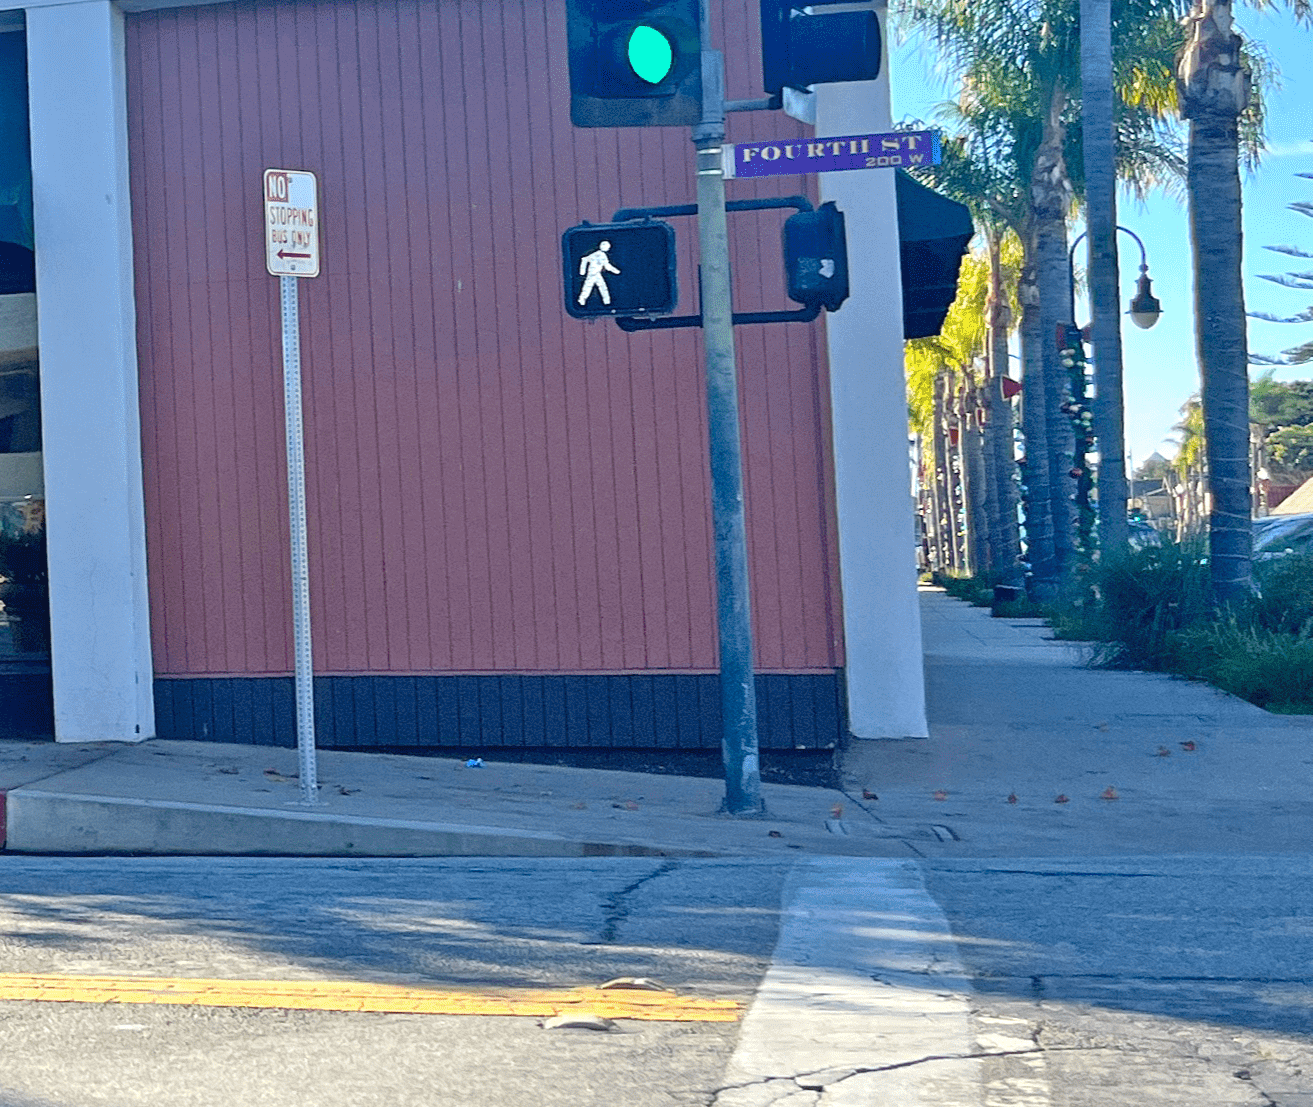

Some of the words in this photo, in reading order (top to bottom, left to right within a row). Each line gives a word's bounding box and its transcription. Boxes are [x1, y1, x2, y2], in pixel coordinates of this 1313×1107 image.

[742, 139, 870, 163] FOURTH
[881, 135, 922, 152] ST
[865, 155, 902, 167] 200
[908, 153, 925, 164] W
[269, 175, 286, 199] NO
[270, 206, 314, 227] STOPPING
[272, 228, 288, 244] BUS
